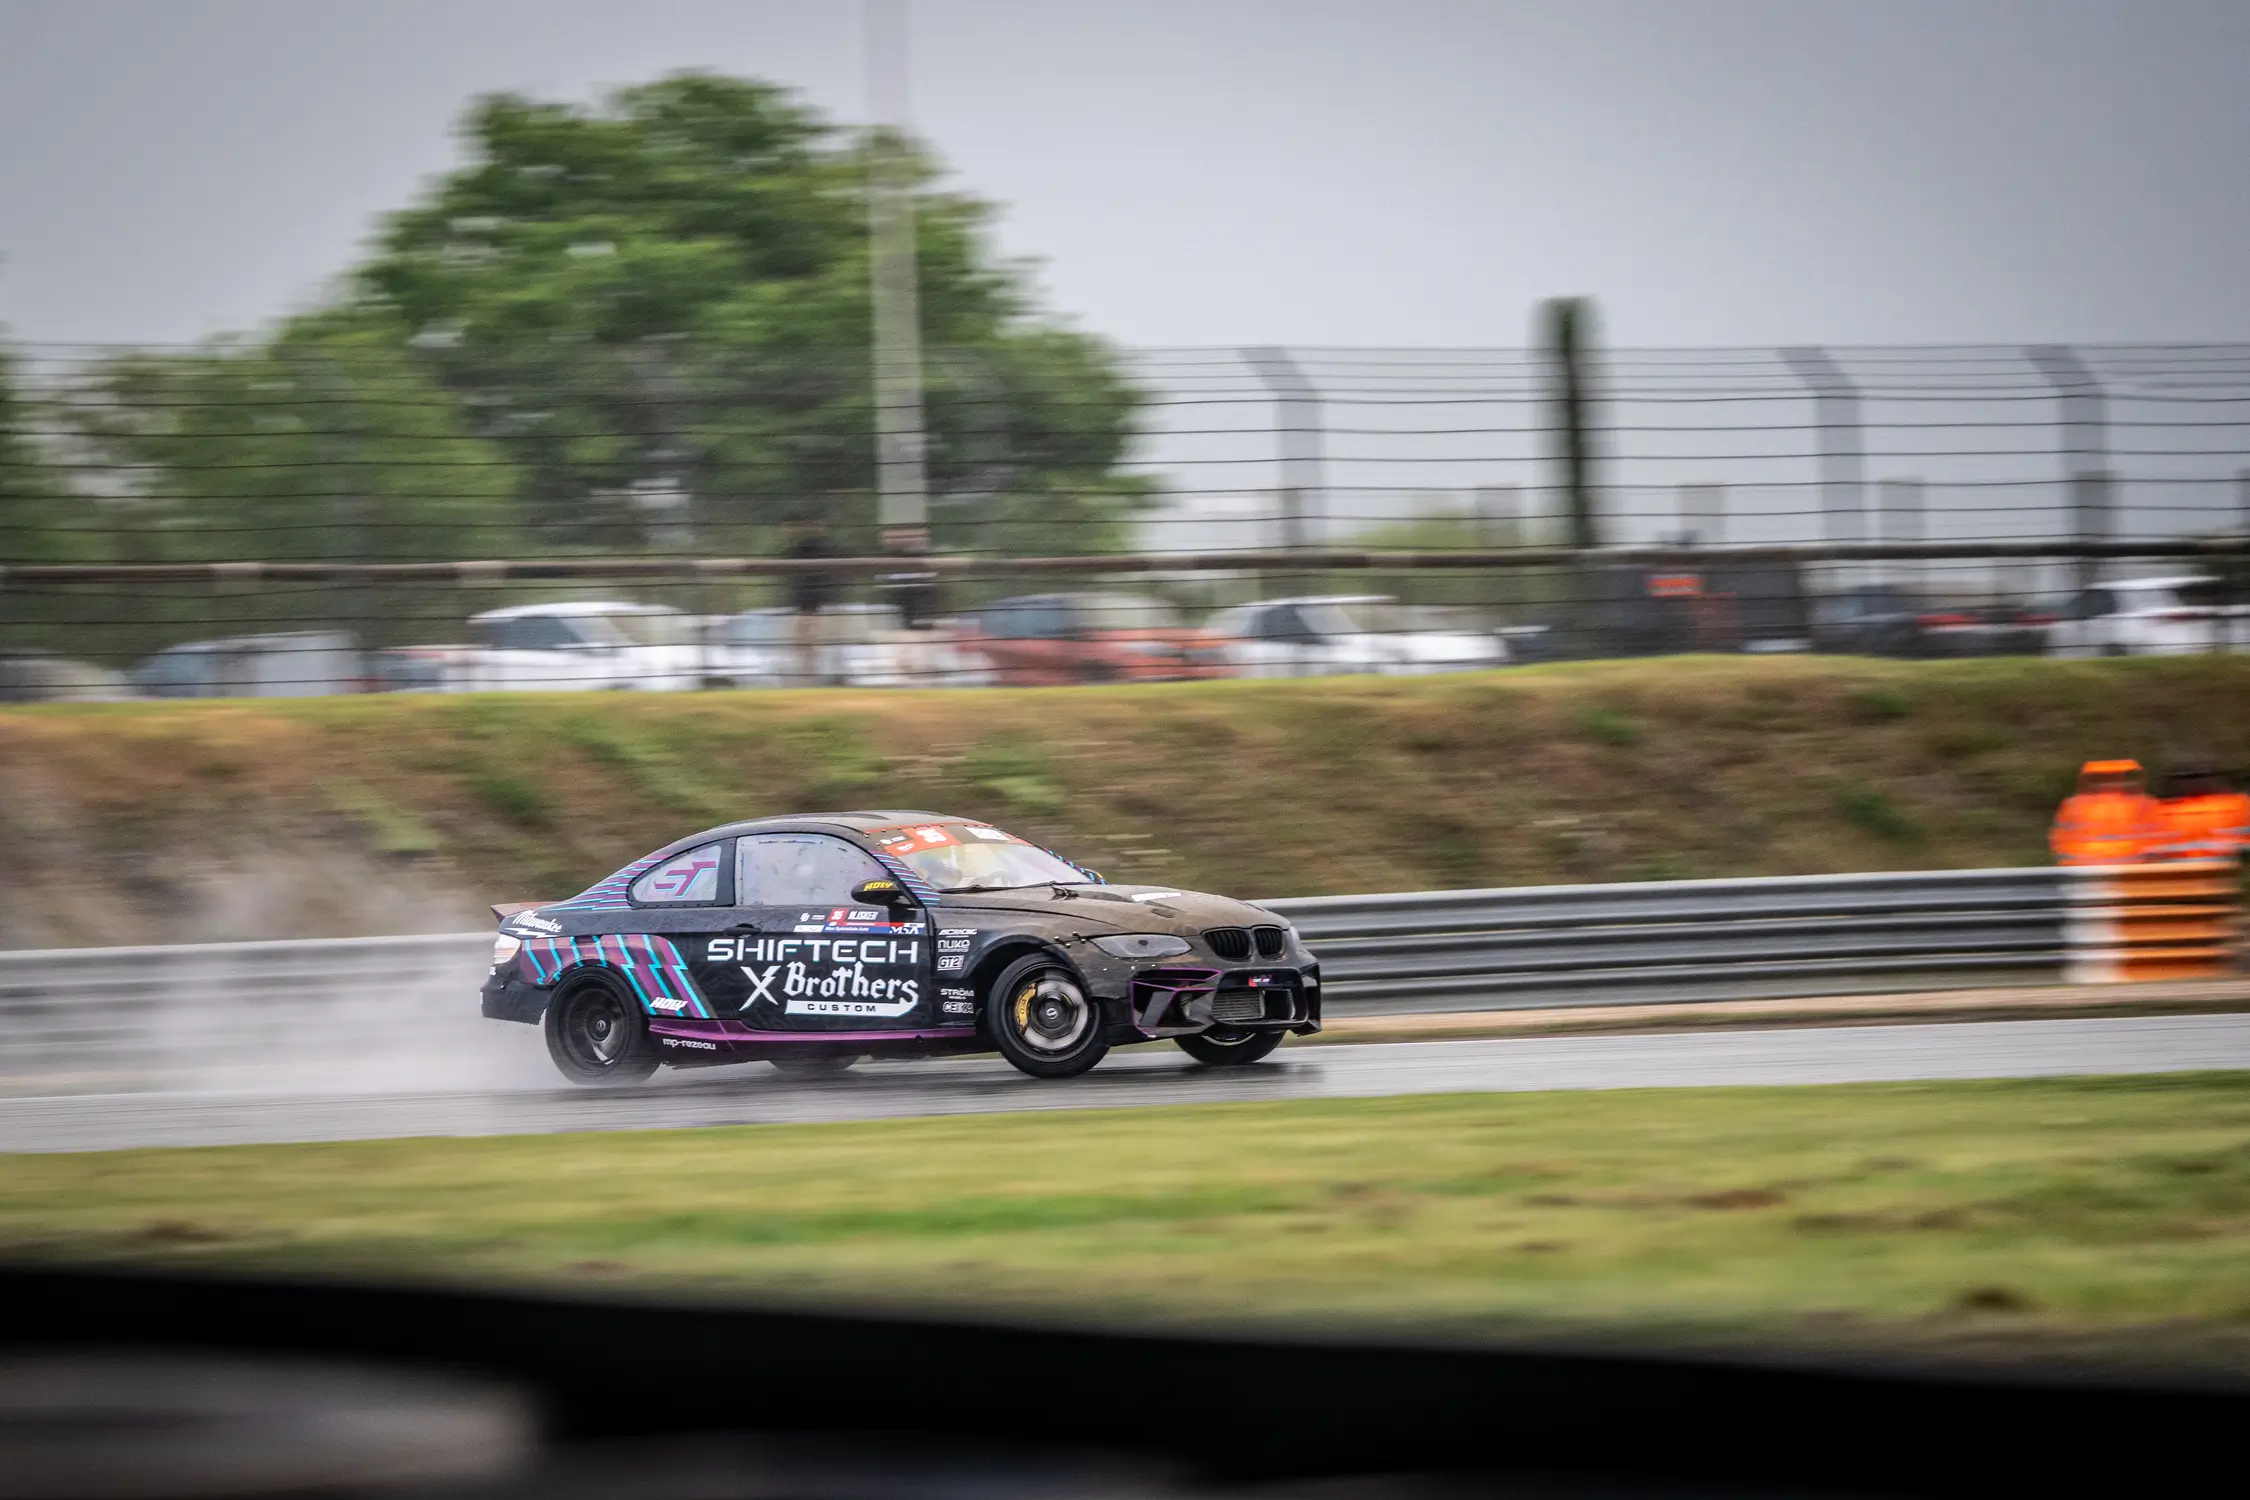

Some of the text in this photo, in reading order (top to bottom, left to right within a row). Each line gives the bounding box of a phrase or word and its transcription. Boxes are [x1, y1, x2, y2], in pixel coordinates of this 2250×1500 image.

[864, 881, 893, 891] HOLY
[512, 910, 563, 933] Milwaukee
[707, 938, 919, 964] SHIFTECH
[783, 961, 919, 1006] Brothers
[940, 987, 975, 997] STRÖM
[807, 1003, 876, 1012] CUSTOM
[662, 1038, 717, 1051] mp-rezeau
